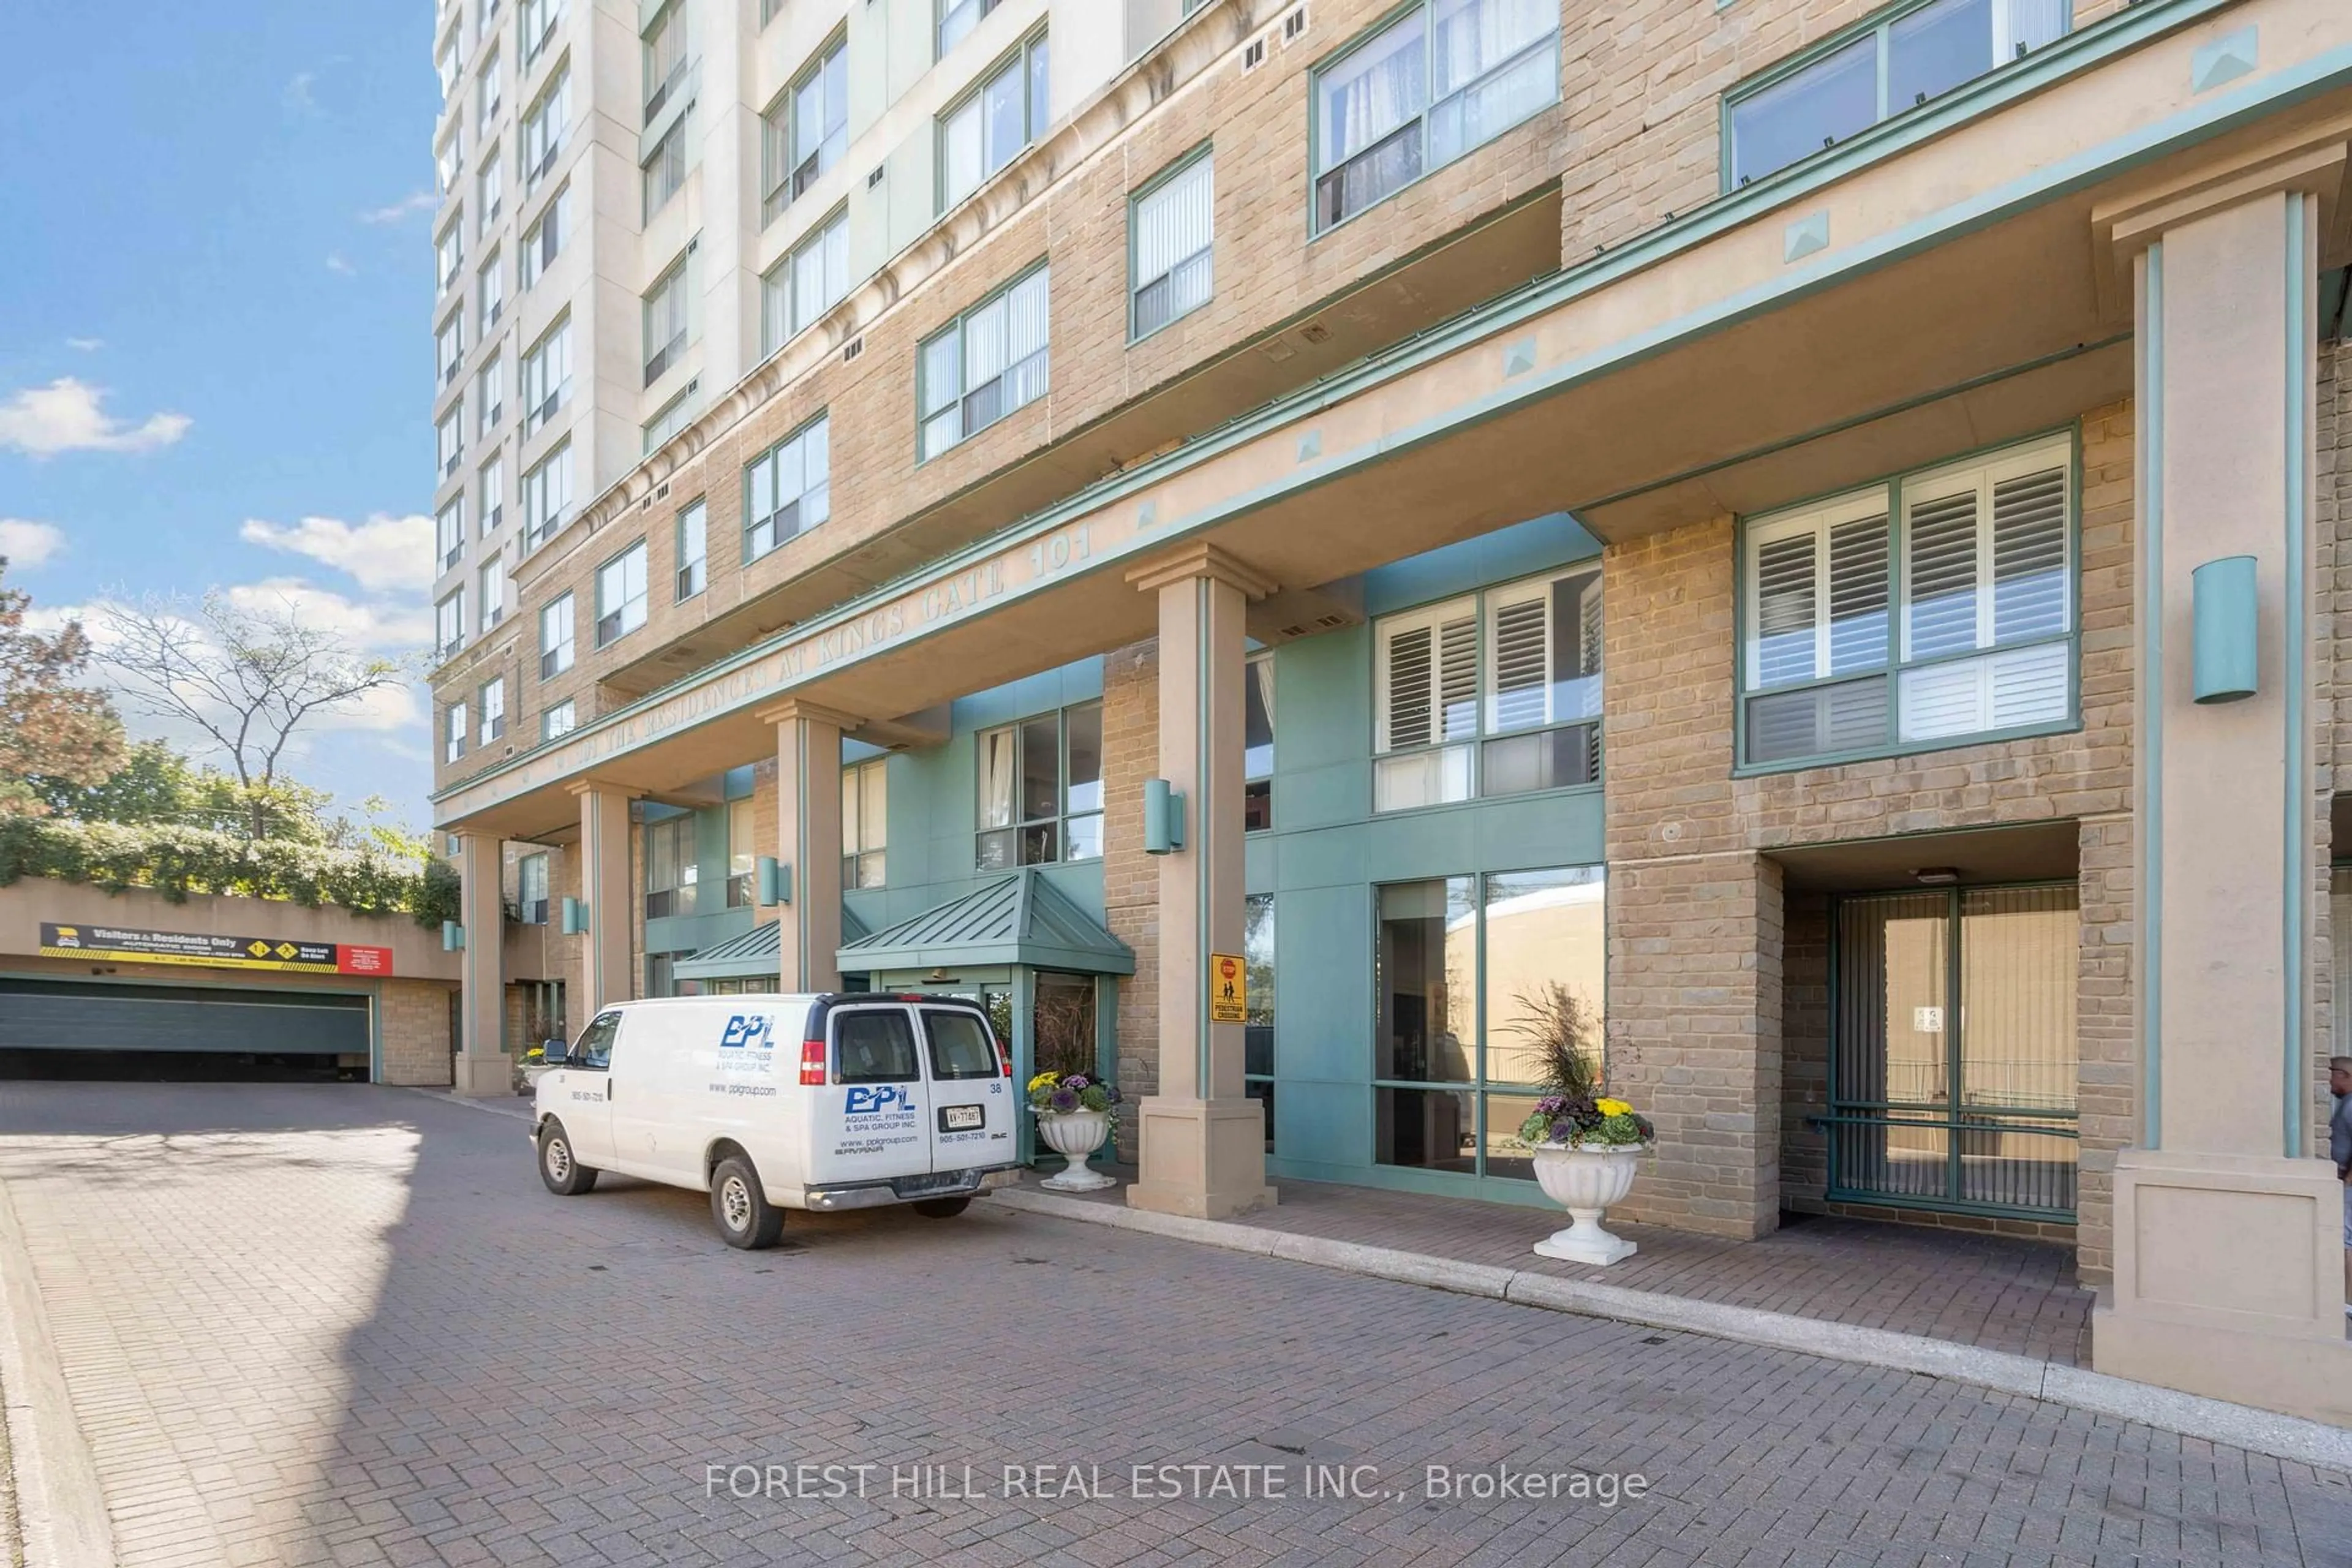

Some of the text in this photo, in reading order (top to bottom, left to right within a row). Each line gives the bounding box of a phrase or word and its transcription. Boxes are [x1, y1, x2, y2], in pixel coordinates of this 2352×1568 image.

[605, 722, 635, 752] THE
[644, 665, 766, 737] RESIDENCES
[778, 644, 808, 683] AT
[817, 603, 905, 667] KINGS
[923, 560, 1006, 620] GATE
[1031, 522, 1093, 579] 101
[93, 929, 140, 941] Visitors
[152, 933, 209, 945] Residents
[211, 937, 236, 949] Only
[990, 1084, 1002, 1094] 38
[845, 1085, 916, 1114] PPL
[885, 1112, 915, 1121] FITNESS
[853, 1123, 870, 1132] SPA
[872, 1122, 900, 1131] GROUP
[866, 1136, 918, 1147] pplgroup.com
[939, 1132, 986, 1144] 905-501-7210
